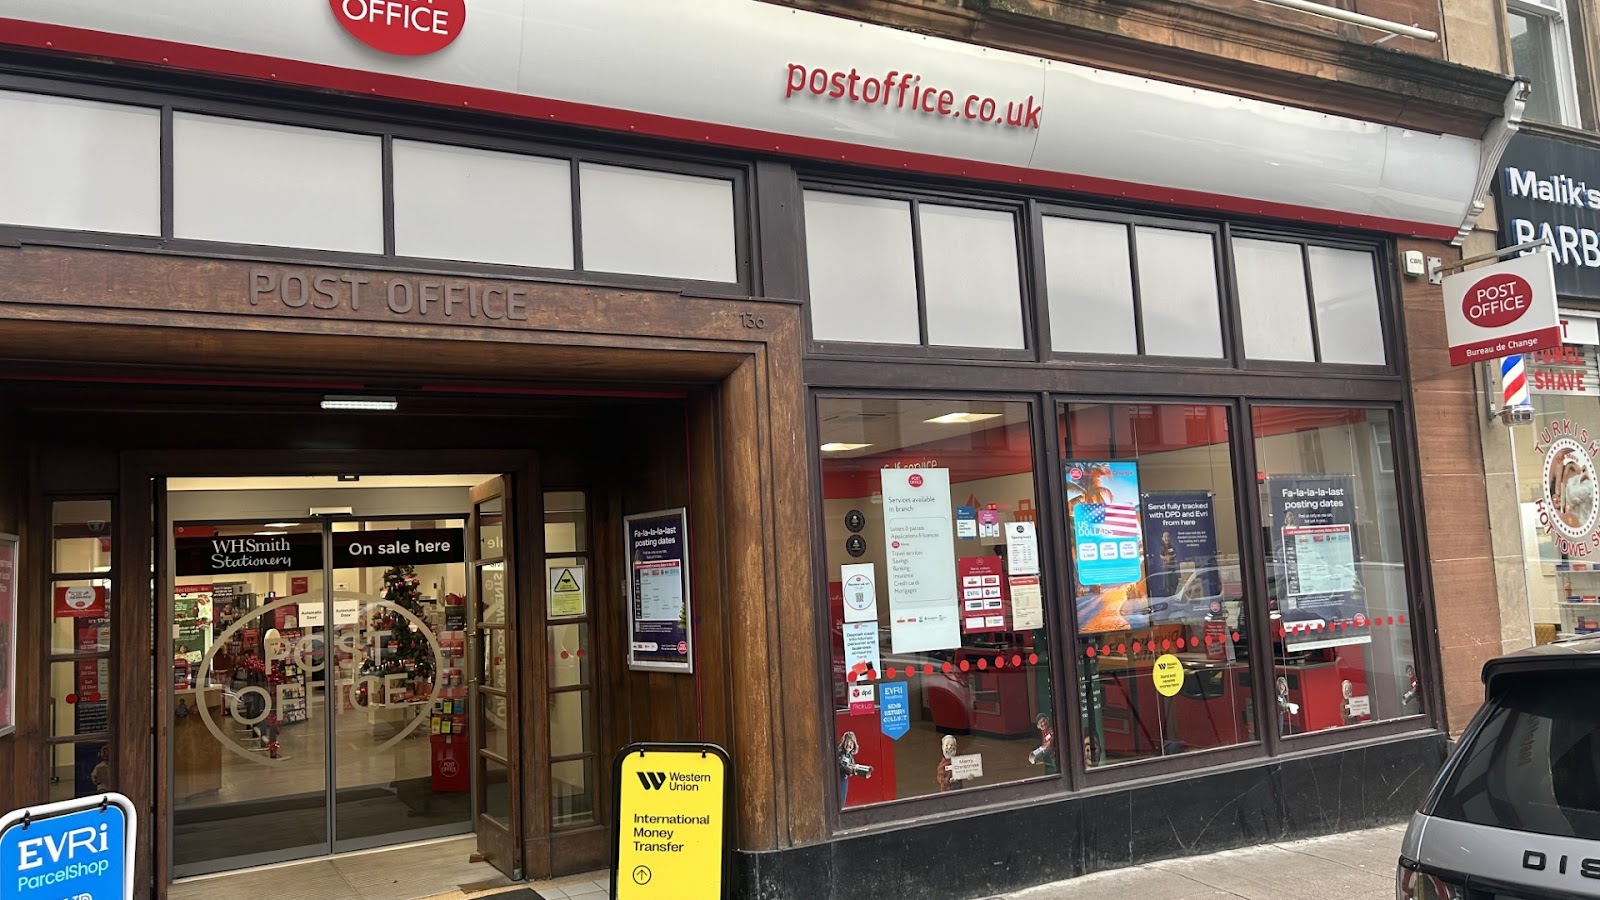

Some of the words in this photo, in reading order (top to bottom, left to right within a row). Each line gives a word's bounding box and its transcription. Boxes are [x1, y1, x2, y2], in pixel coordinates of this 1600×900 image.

[341, 0, 450, 35] OFFICE
[785, 62, 1042, 129] postoffice.co.uk
[1508, 166, 1600, 208] Malik's
[248, 268, 369, 311] POST
[386, 275, 529, 321] OFFICE
[1477, 281, 1516, 302] POST
[1469, 295, 1525, 319] OFFICE
[739, 313, 765, 329] 136
[1466, 346, 1494, 357] Bureau
[1496, 343, 1506, 352] de
[1507, 336, 1538, 350] Change
[1534, 370, 1586, 391] SHAVE
[1535, 419, 1599, 457] TURKISH
[1282, 488, 1344, 497] Fa-la-la-la-last
[1285, 500, 1318, 510] posting
[634, 526, 676, 538] Fa-la-la-la-last
[1078, 528, 1114, 536] DOLLARS
[1535, 499, 1555, 535] HOT
[1554, 532, 1592, 558] TOWEL
[212, 538, 291, 554] WHSmith
[349, 542, 373, 556] On
[378, 540, 410, 554] sale
[414, 539, 451, 554] here
[635, 538, 657, 549] posting
[211, 553, 292, 569] Stationery
[264, 630, 392, 676] POST
[230, 672, 409, 725] OFFICE
[669, 772, 711, 782] Western
[669, 782, 699, 791] Union
[634, 813, 710, 825] International
[633, 827, 674, 840] Money
[18, 823, 110, 870] EVRi
[633, 841, 684, 852] Transfer
[18, 860, 110, 892] ParcelShop
